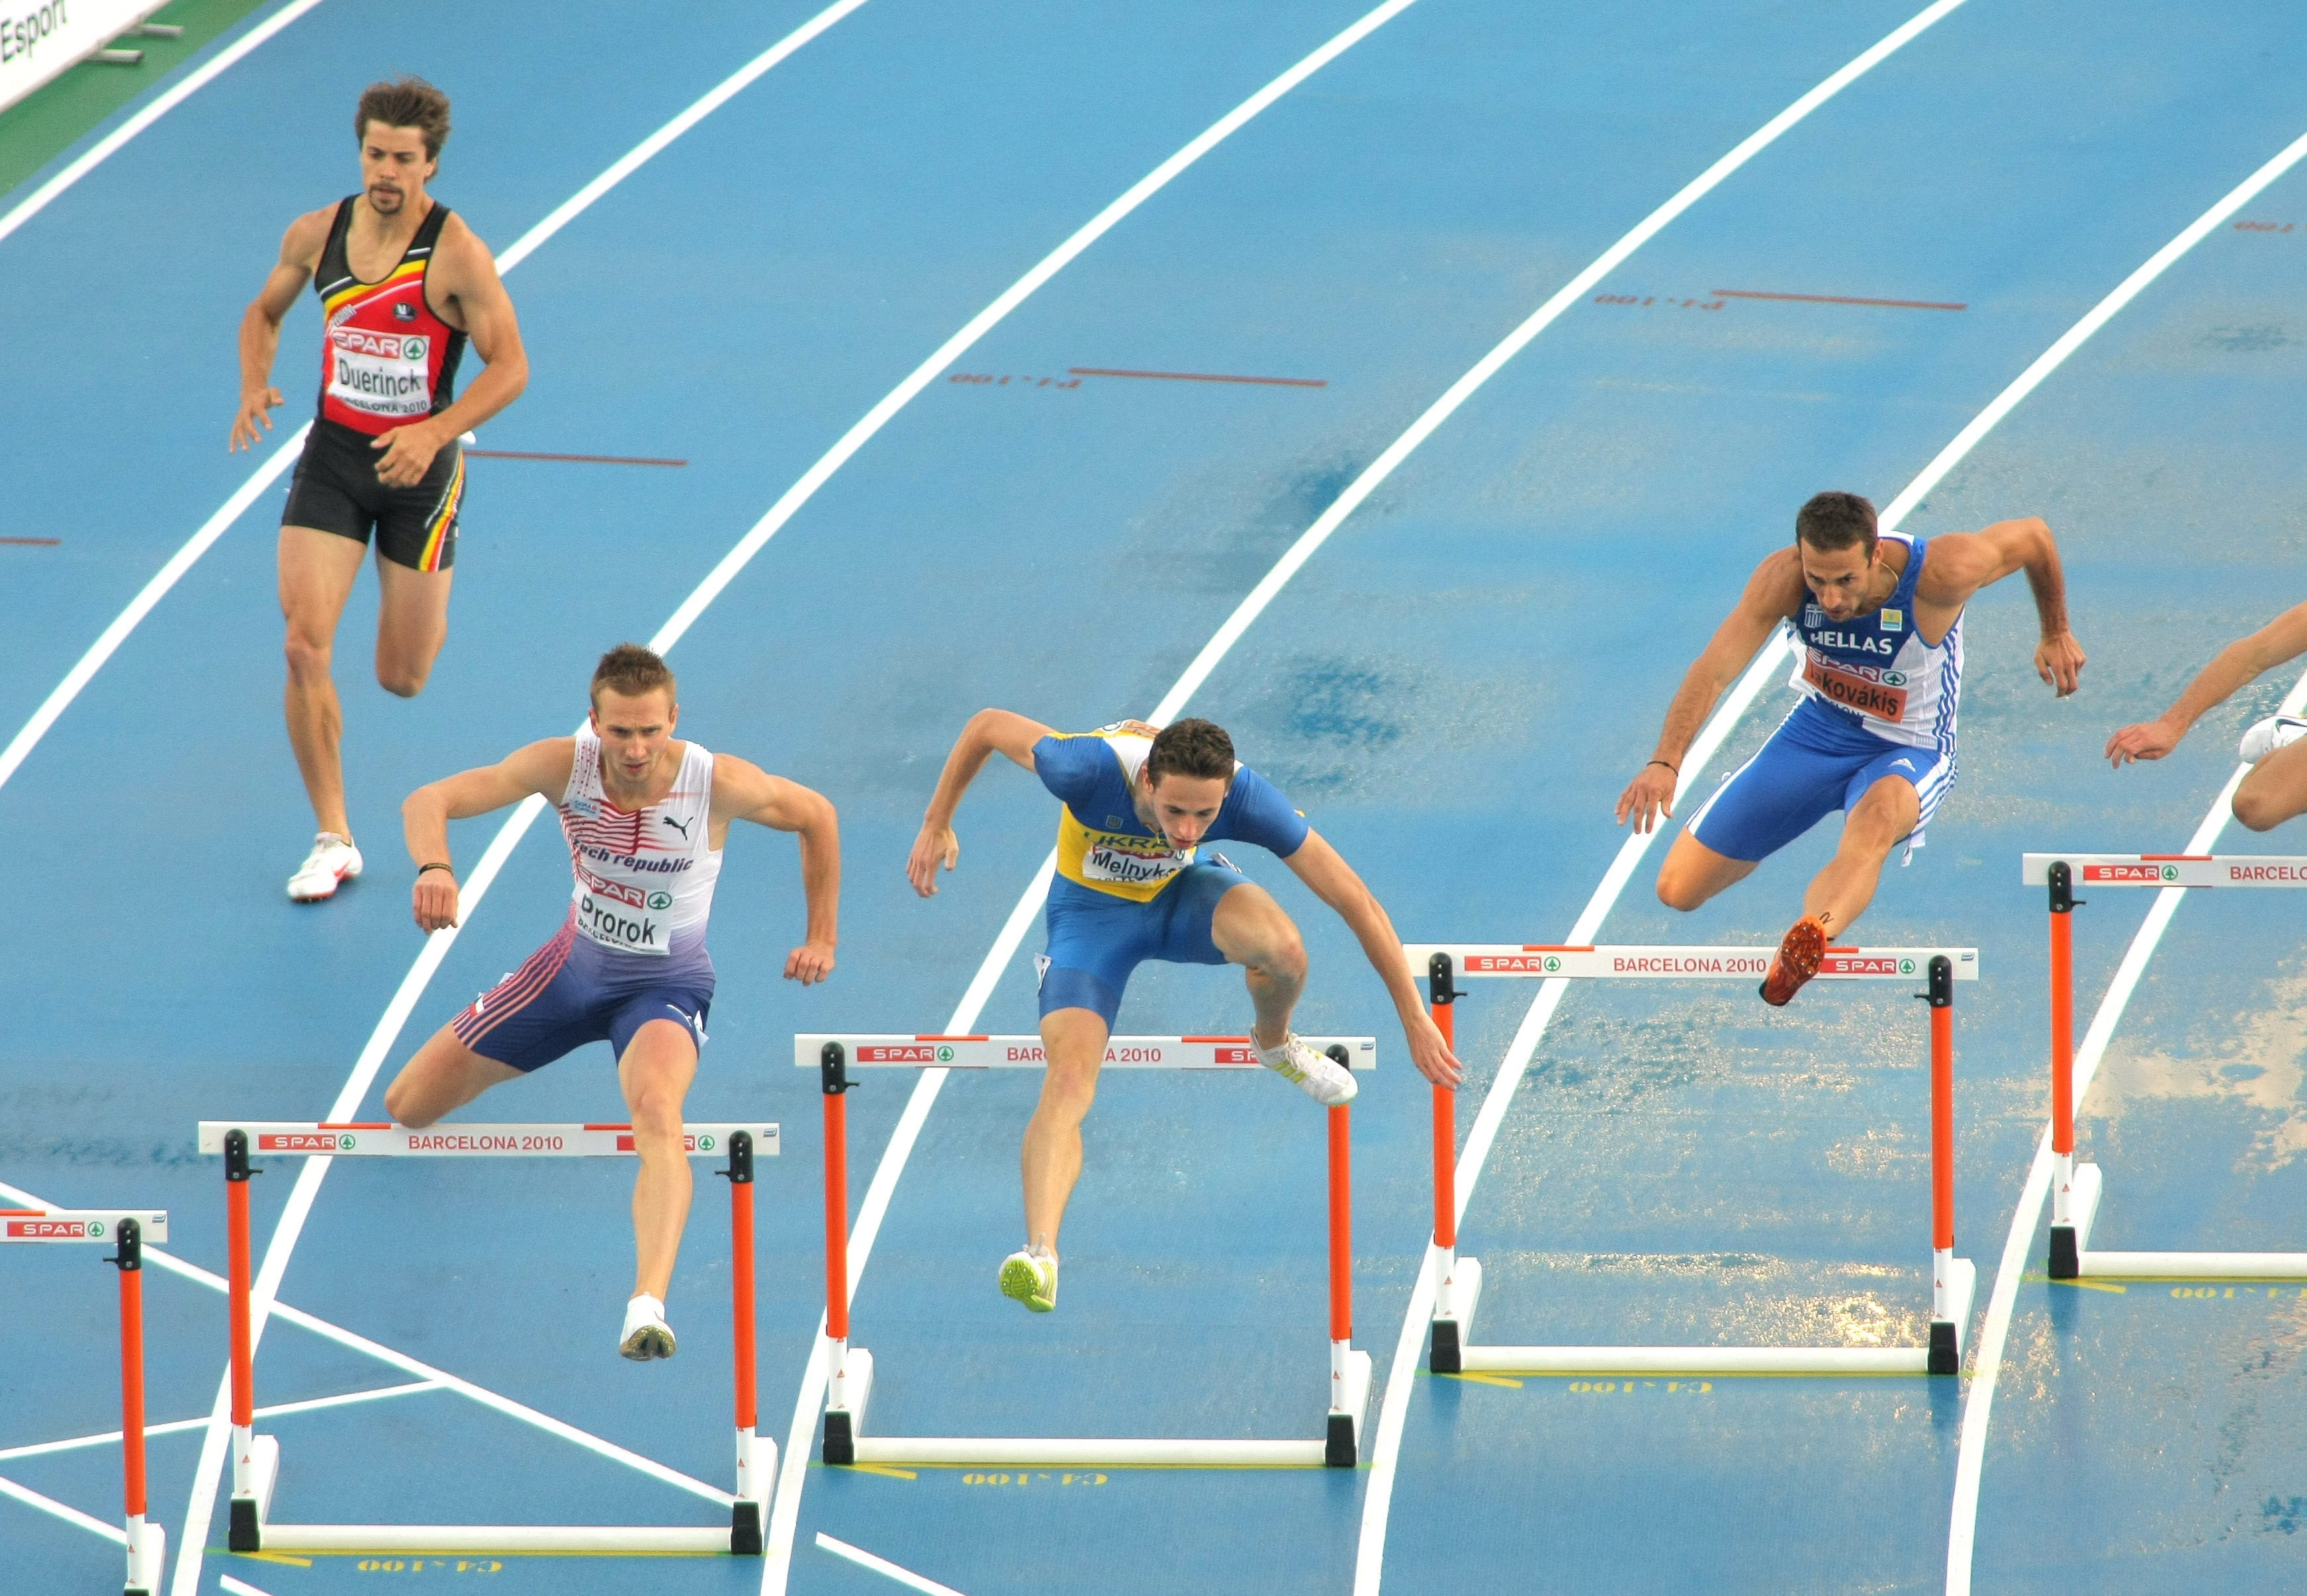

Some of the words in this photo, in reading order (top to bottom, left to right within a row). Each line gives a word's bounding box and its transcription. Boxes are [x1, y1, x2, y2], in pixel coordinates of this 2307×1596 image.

[333, 332, 400, 356] SPAR
[339, 358, 421, 396] Duerinck
[402, 400, 428, 413] 2010
[1810, 631, 1893, 655] HELLAS
[1807, 646, 1878, 682] SPAR
[613, 854, 694, 873] republic
[2099, 867, 2159, 878] SPAR
[578, 865, 643, 907] SPAR
[1480, 958, 1541, 969] SPAR
[1614, 958, 1722, 972] BARCELONA
[1726, 958, 1766, 973] 2010
[1835, 961, 1896, 971] SPAR
[873, 1048, 933, 1059] SPAR
[1120, 1048, 1161, 1062] 2010
[275, 1137, 335, 1147] SPAR
[408, 1135, 518, 1149] BARCELONA
[522, 1135, 563, 1150] 2010
[23, 1224, 84, 1235] SPAR
